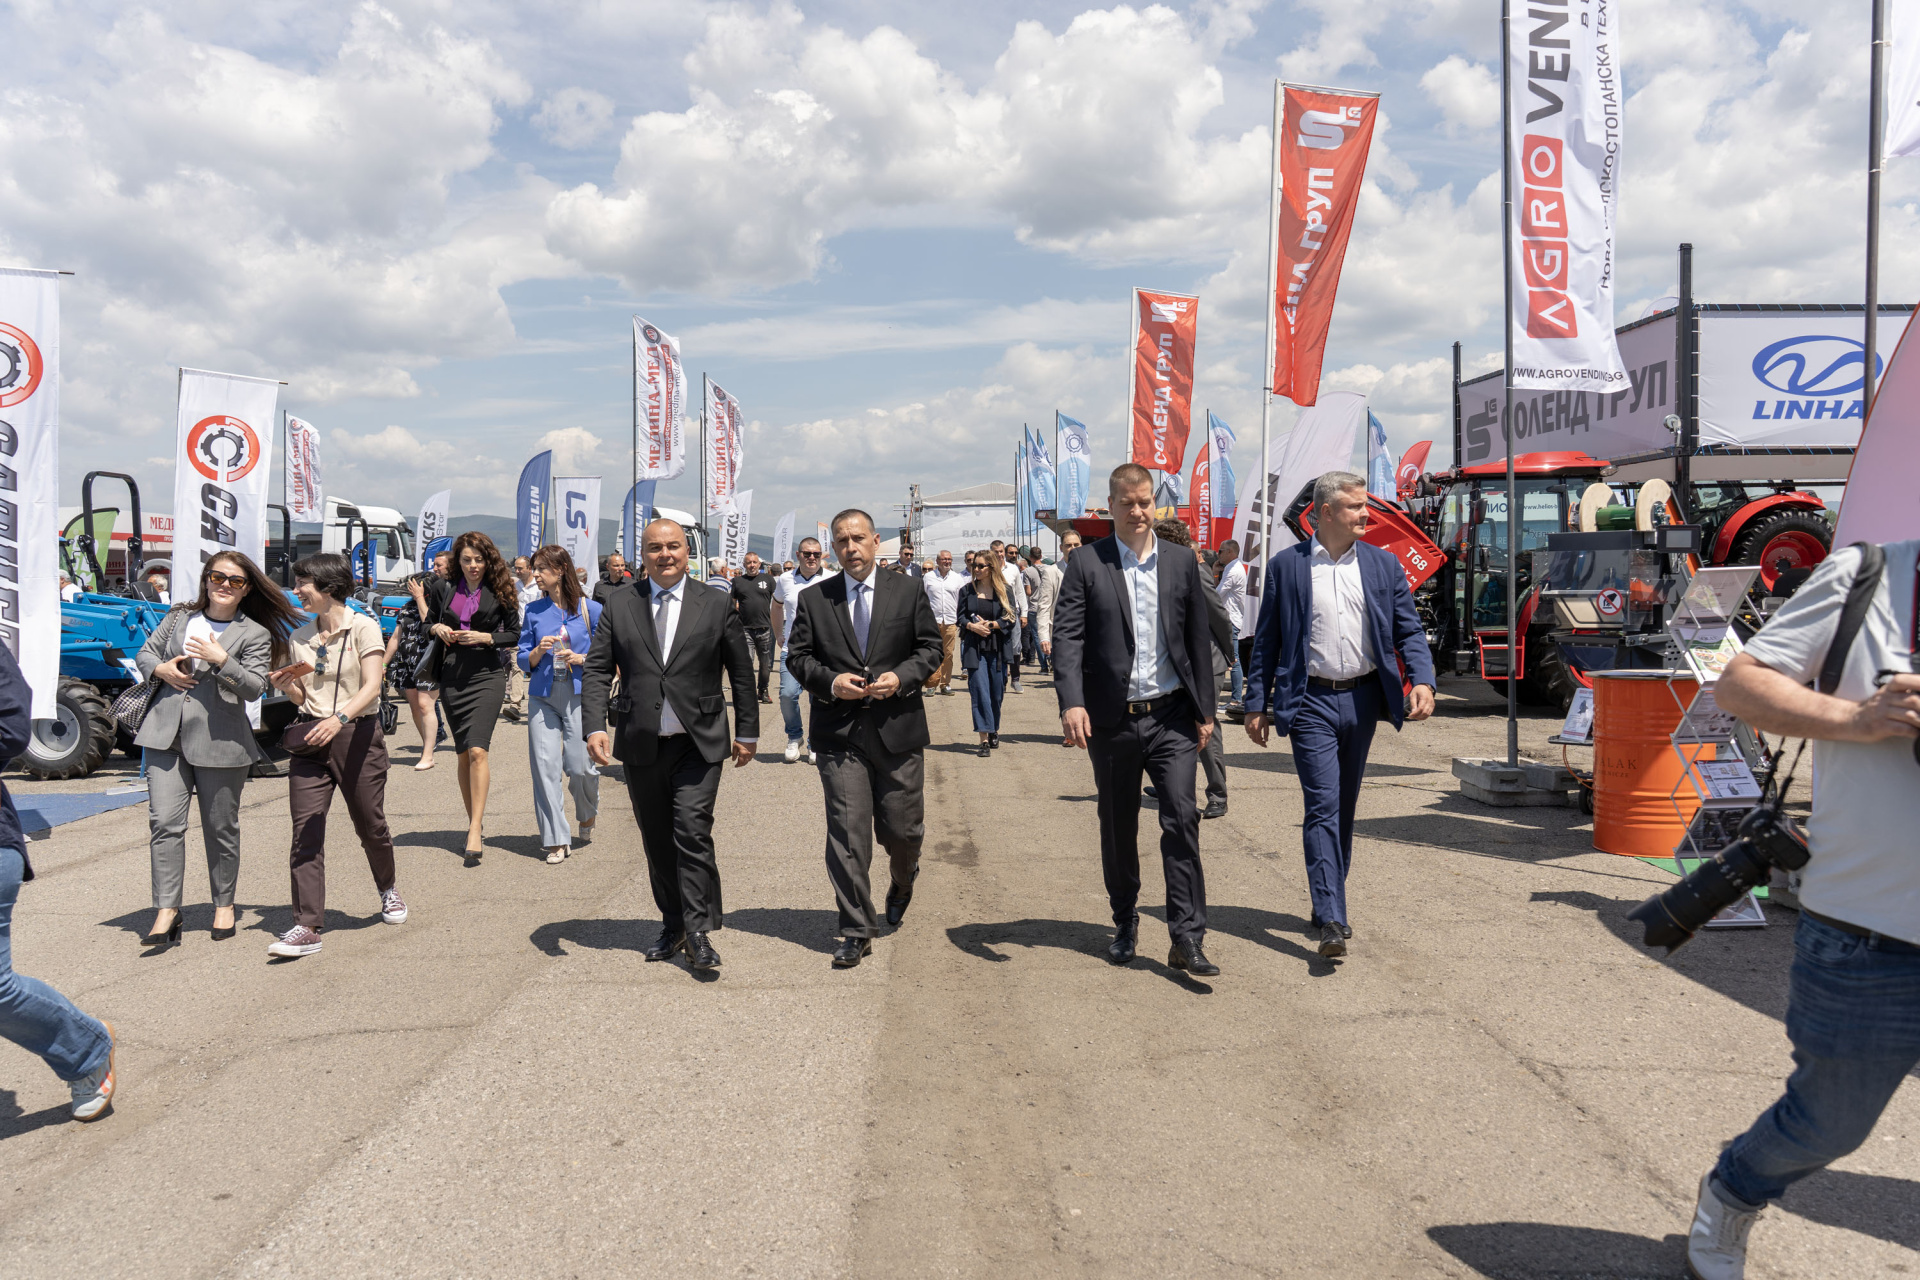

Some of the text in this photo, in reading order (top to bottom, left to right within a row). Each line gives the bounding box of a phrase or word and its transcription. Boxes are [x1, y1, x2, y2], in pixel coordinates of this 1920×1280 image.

[1526, 0, 1570, 124] VEN
[647, 346, 662, 469] МЕДИНА-МЕД
[1153, 333, 1173, 465] СОЛЕНД ГРУП
[715, 401, 727, 495] МЕДИНА-МЕД
[201, 483, 238, 564] CA
[566, 490, 587, 530] LS
[1406, 546, 1428, 571] T68
[382, 608, 396, 617] LS
